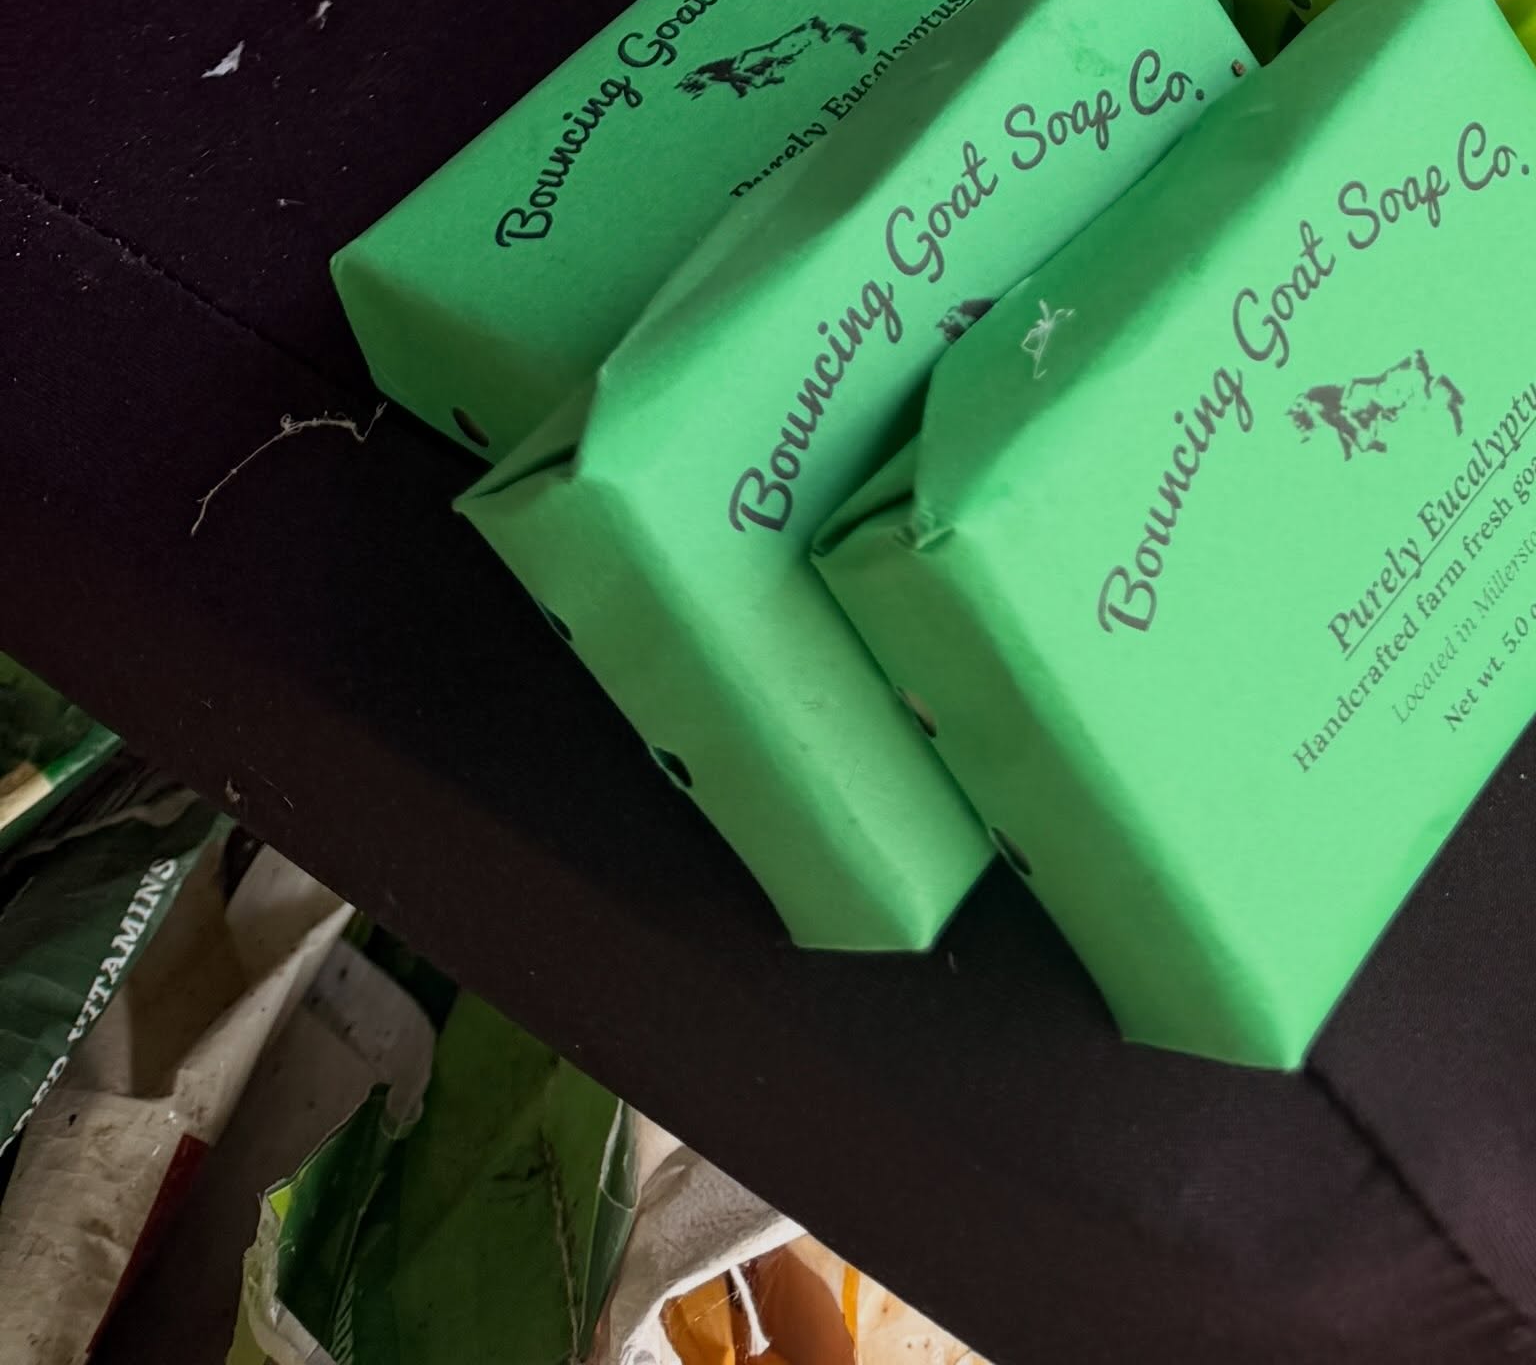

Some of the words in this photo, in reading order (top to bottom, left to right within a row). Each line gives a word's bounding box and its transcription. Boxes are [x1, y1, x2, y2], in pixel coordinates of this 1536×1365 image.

[495, 66, 644, 248] Bouncing
[728, 277, 905, 535] Bouncing
[886, 142, 998, 282] Goat
[1003, 91, 1120, 171] Soap
[1128, 49, 1206, 115] Co.
[1097, 363, 1254, 633] Bouncing
[1233, 220, 1337, 368] Goat
[1338, 165, 1451, 250] Soap
[1456, 120, 1531, 192] Co.
[1293, 613, 1420, 773] Handcrafted
[1416, 559, 1467, 618] farm
[1462, 499, 1514, 560] fresh
[1328, 537, 1423, 653] Purely
[1391, 637, 1459, 725] Located
[1455, 616, 1478, 642] in
[1443, 688, 1479, 733] Net
[1477, 660, 1505, 689] wt.
[1502, 616, 1530, 654] 5.0
